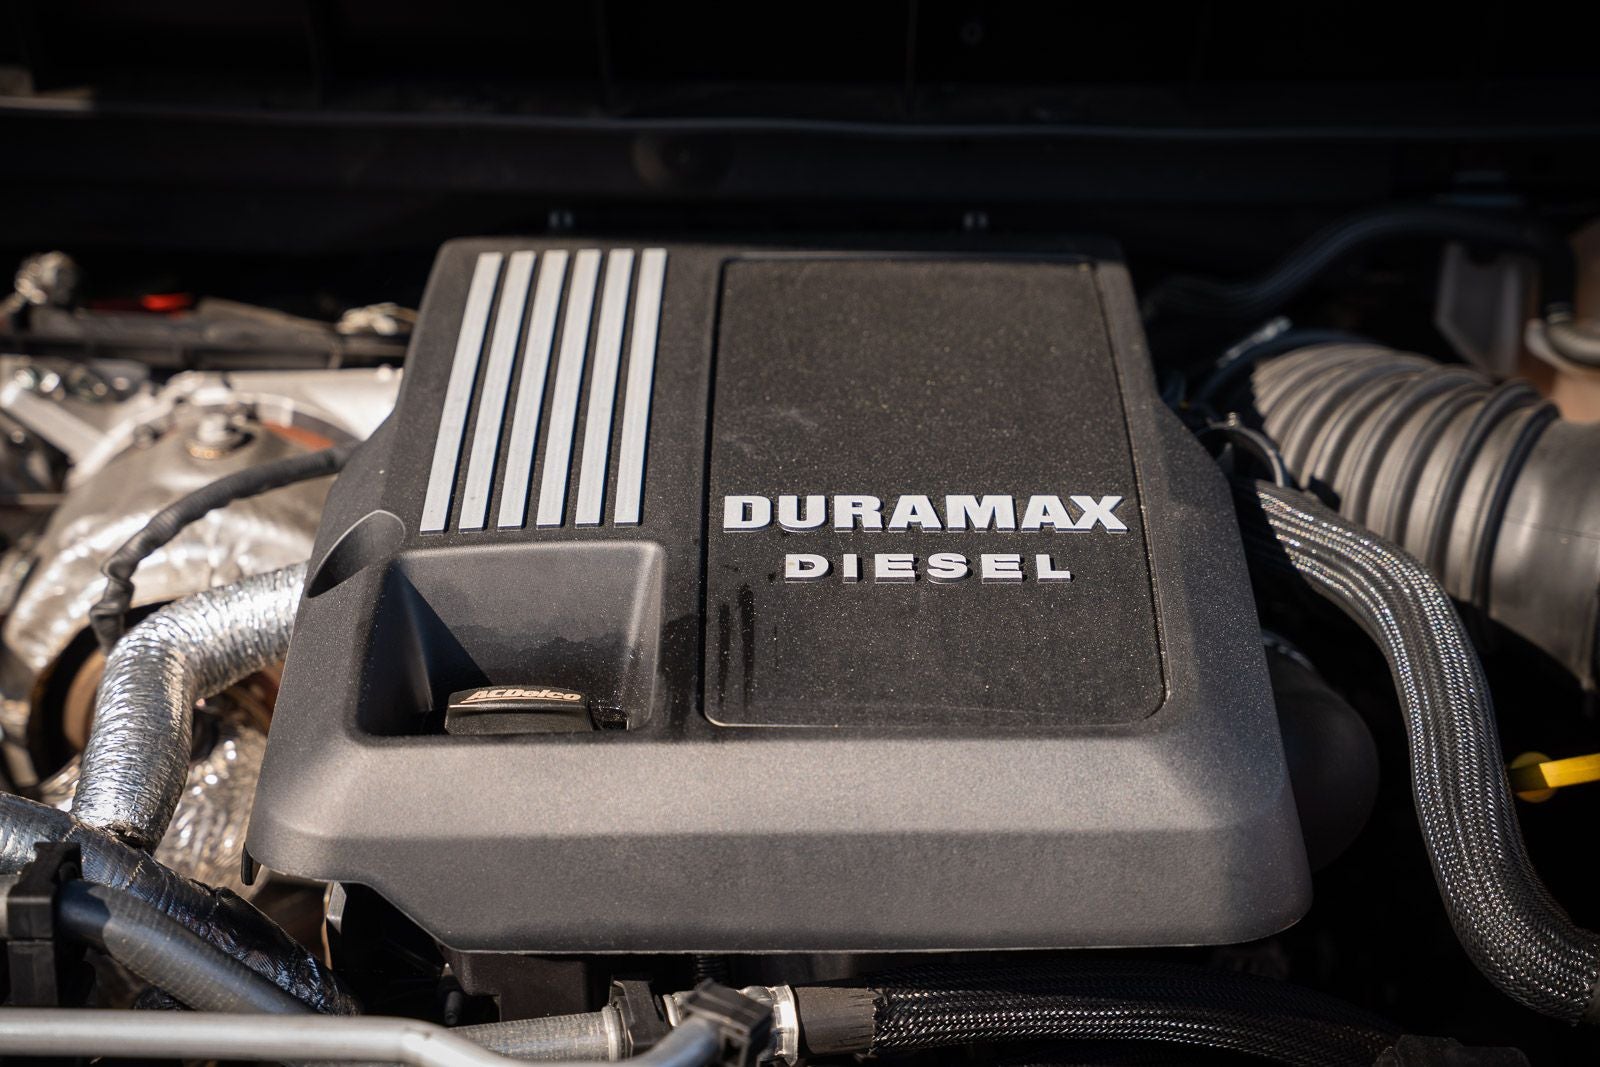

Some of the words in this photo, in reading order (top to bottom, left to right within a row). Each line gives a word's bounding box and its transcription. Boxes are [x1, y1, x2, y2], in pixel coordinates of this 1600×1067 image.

[723, 495, 1128, 533] DURAMAX
[785, 553, 1072, 584] DIESEL
[468, 688, 582, 702] ACDelco
